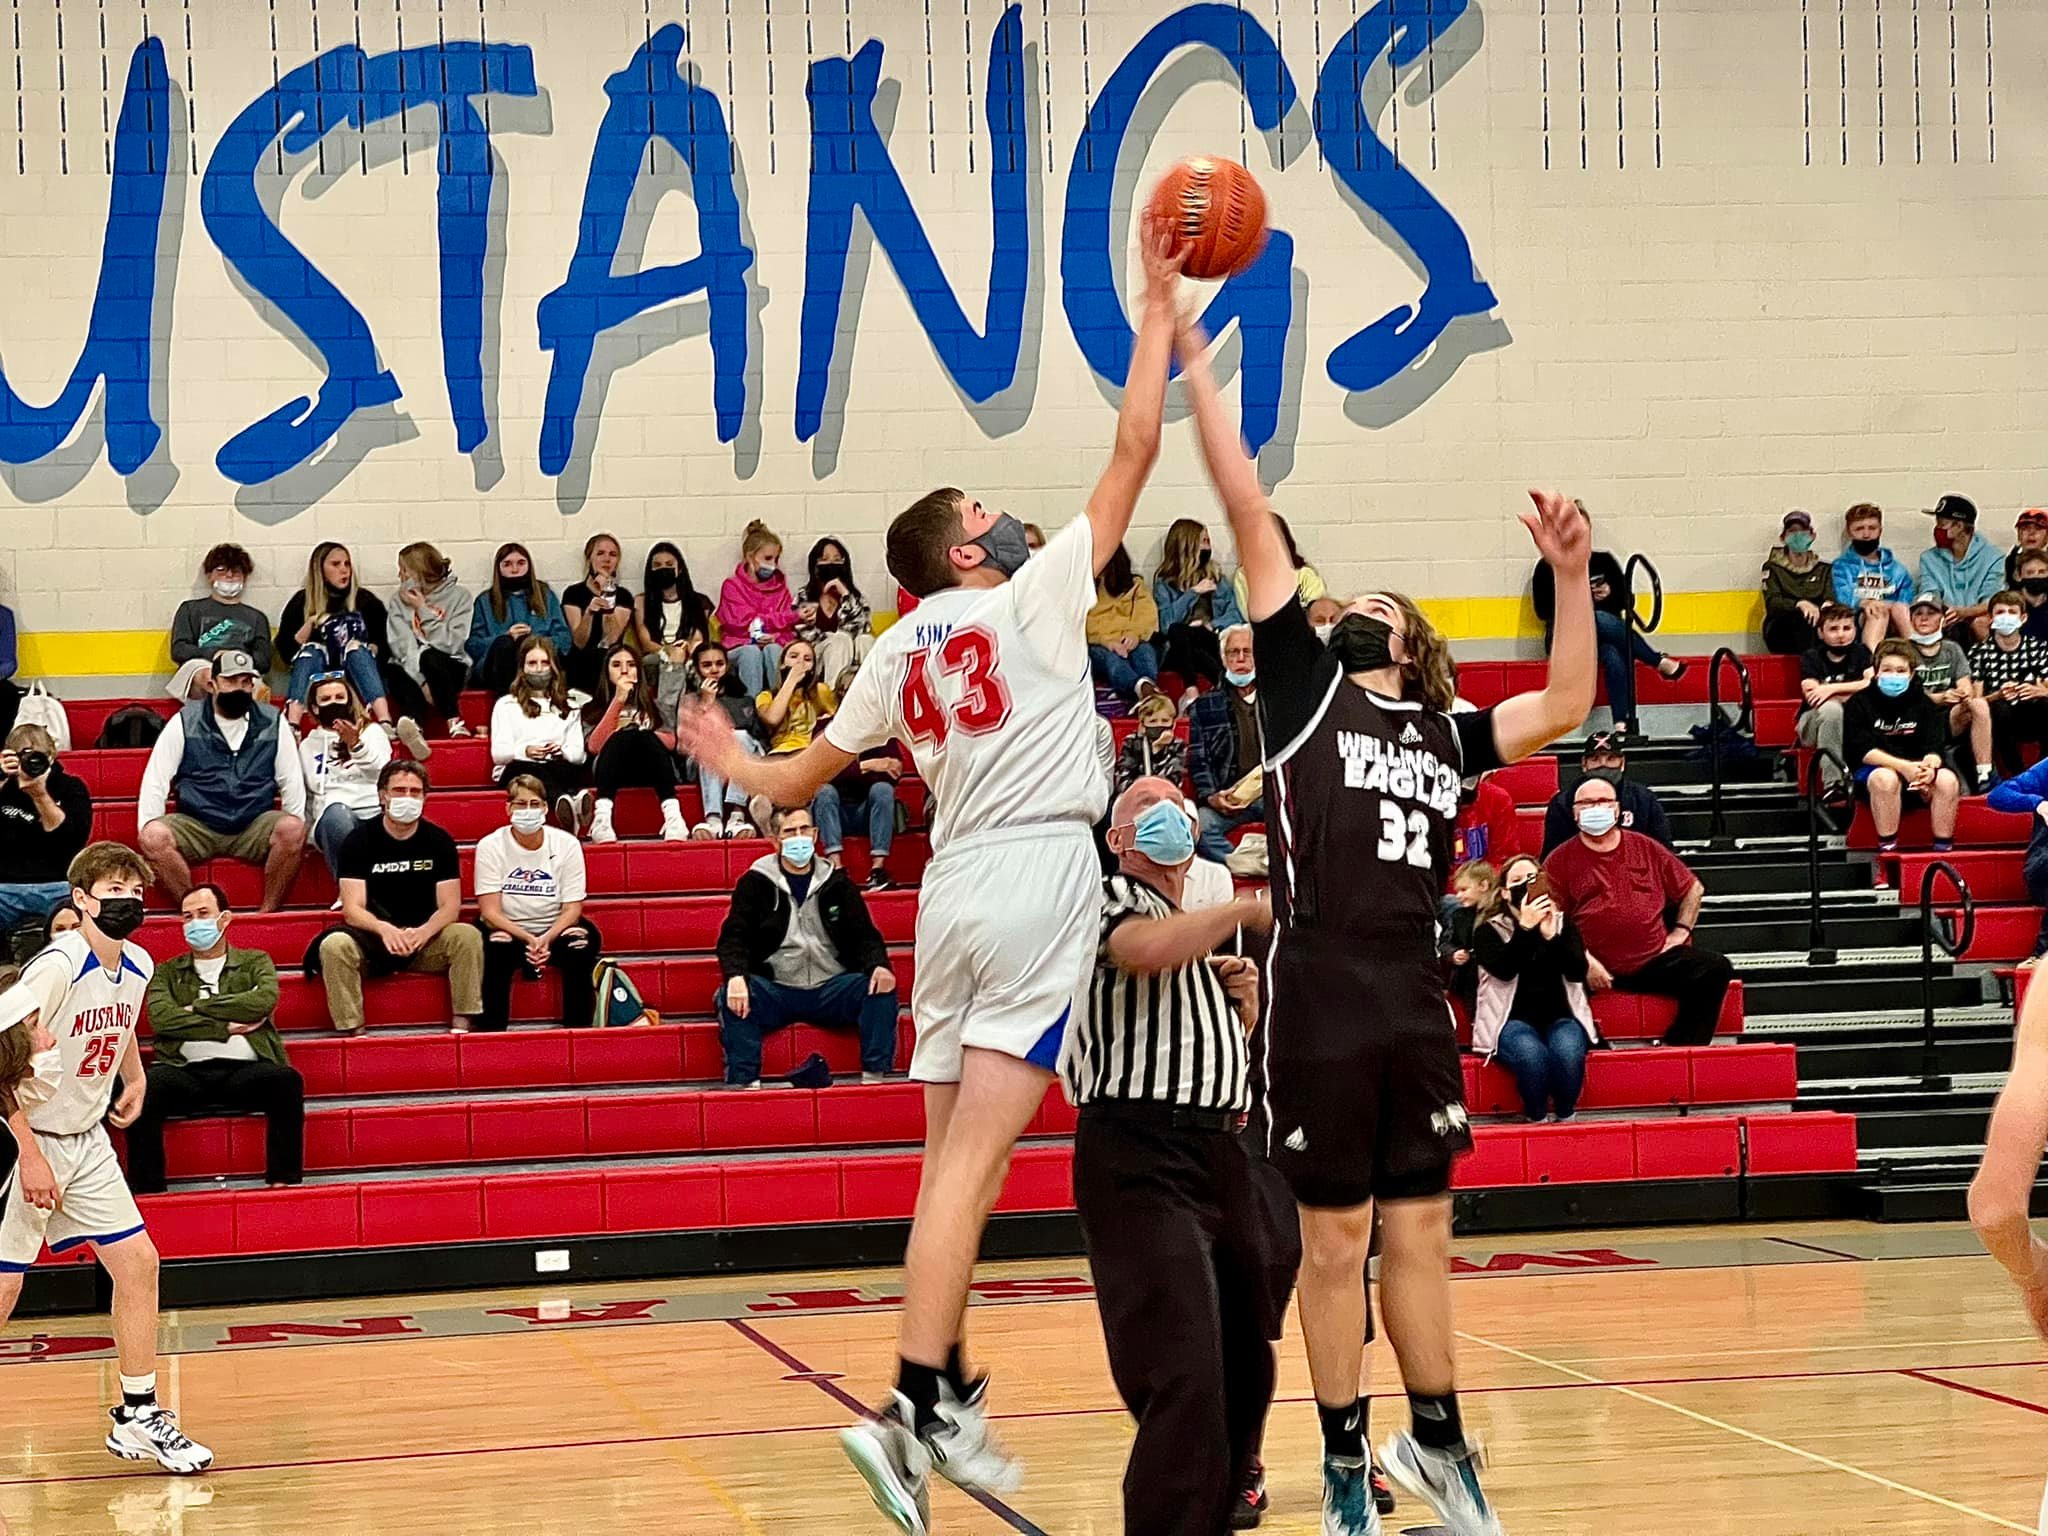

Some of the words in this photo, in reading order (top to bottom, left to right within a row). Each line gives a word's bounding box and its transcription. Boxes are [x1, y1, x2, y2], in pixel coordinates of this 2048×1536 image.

[898, 623, 1013, 757] 43
[1337, 730, 1461, 797] WELLINGON
[1344, 757, 1458, 820] EAGLES
[1377, 799, 1432, 869] 32
[76, 1033, 121, 1077] 25
[0, 1248, 1660, 1360] MSTANG
